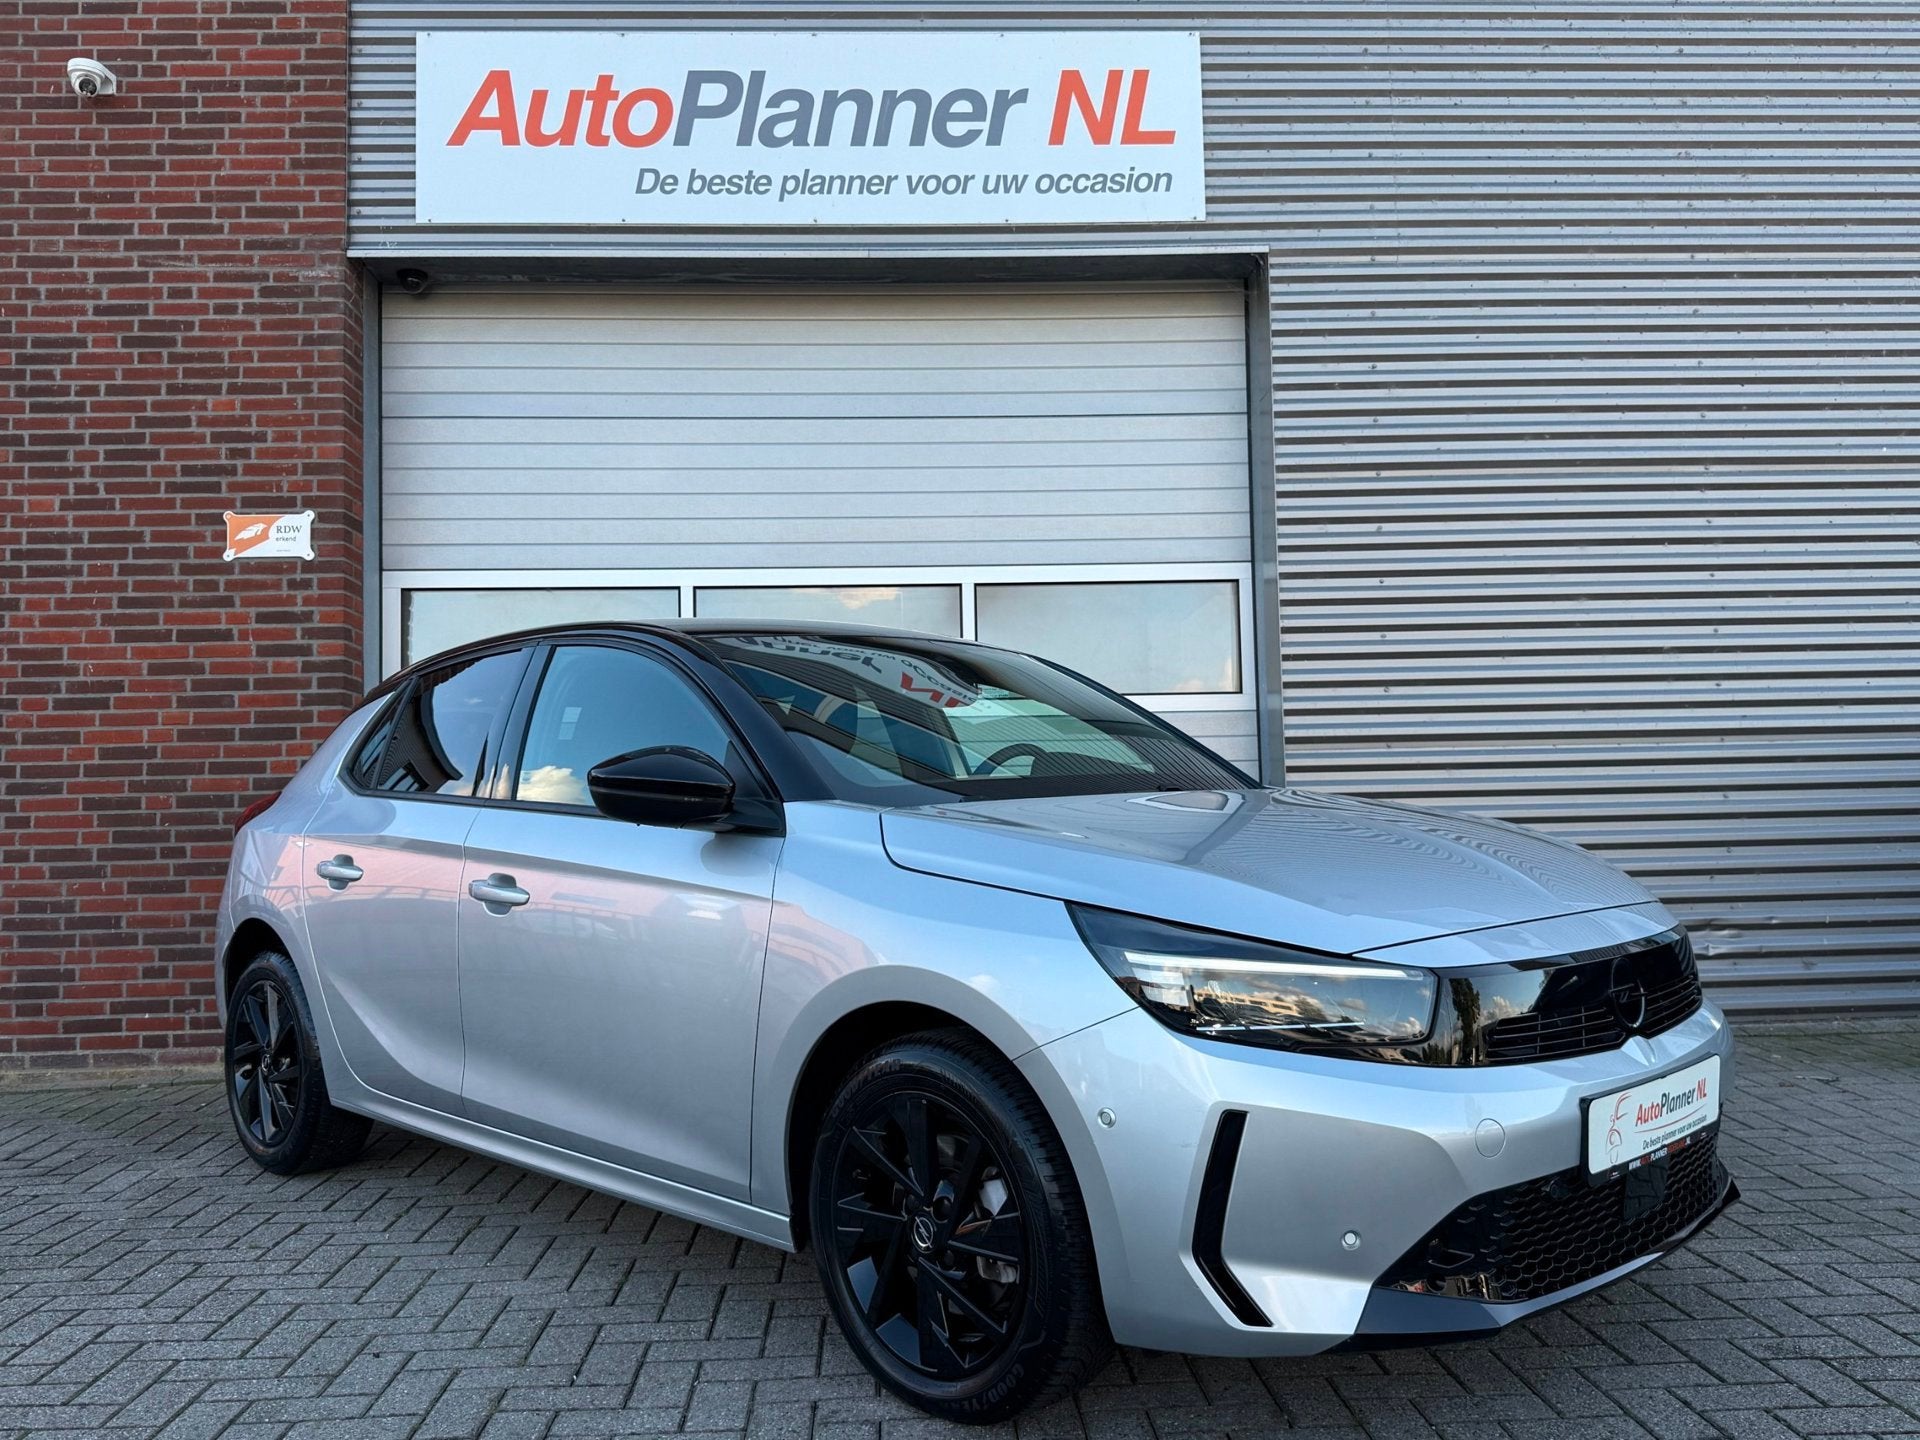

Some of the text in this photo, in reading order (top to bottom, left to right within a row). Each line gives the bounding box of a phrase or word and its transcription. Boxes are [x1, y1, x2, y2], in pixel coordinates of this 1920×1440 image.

[446, 69, 1176, 148] AutoPlanner NL
[635, 167, 1173, 202] De beste planner voor uw occasion
[276, 525, 302, 534] RDW
[1635, 1078, 1707, 1127] AutoPlanner NL
[1642, 1139, 1649, 1150] De
[1649, 1135, 1661, 1147] beste
